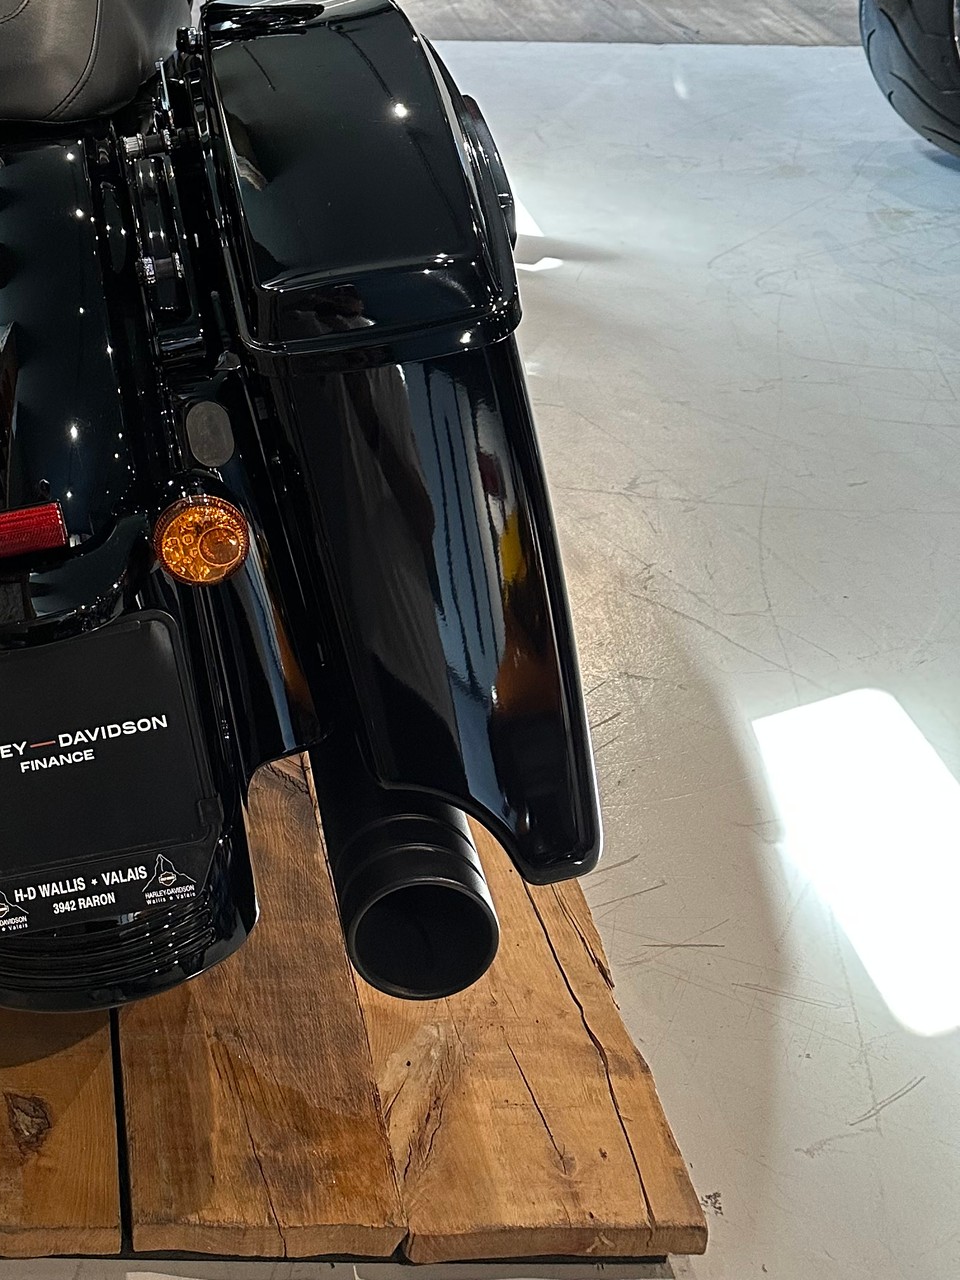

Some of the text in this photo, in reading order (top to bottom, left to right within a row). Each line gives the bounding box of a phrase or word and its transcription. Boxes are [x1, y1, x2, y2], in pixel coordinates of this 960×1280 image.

[58, 714, 169, 748] DAVIDSON
[19, 748, 96, 773] FINANCE
[14, 865, 148, 903] H-D WALLIS VALAIS
[53, 891, 117, 915] 3942 RARON
[146, 891, 197, 906] Wallis Valais
